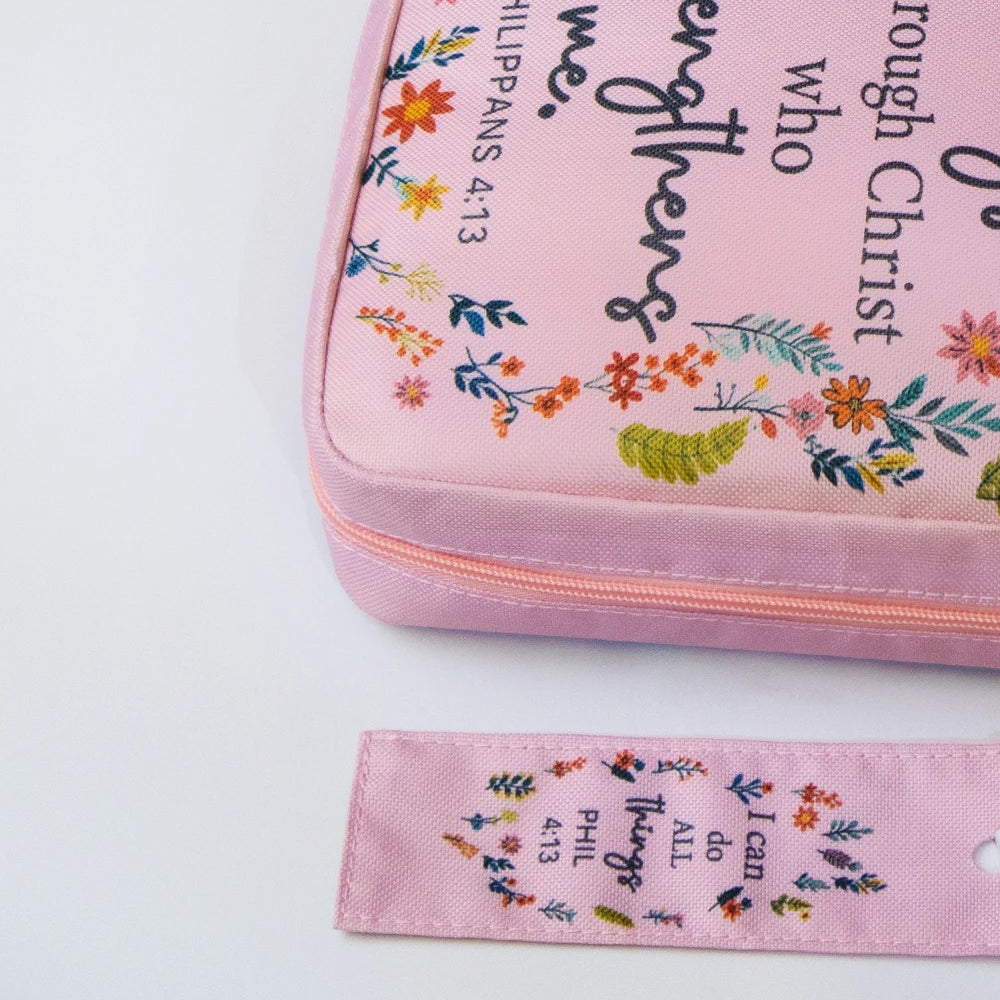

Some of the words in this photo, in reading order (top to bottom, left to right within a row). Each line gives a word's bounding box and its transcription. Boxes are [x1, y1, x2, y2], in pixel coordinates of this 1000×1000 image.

[538, 4, 599, 120] me.
[770, 56, 843, 175] who
[457, 176, 494, 245] 4:13
[853, 159, 925, 346] Christ
[539, 817, 562, 863] 4:13
[572, 809, 599, 867] PHIL
[603, 793, 666, 893] things
[671, 818, 694, 869] ALL
[748, 810, 776, 823] I
[706, 831, 732, 862] do
[743, 831, 766, 880] can
